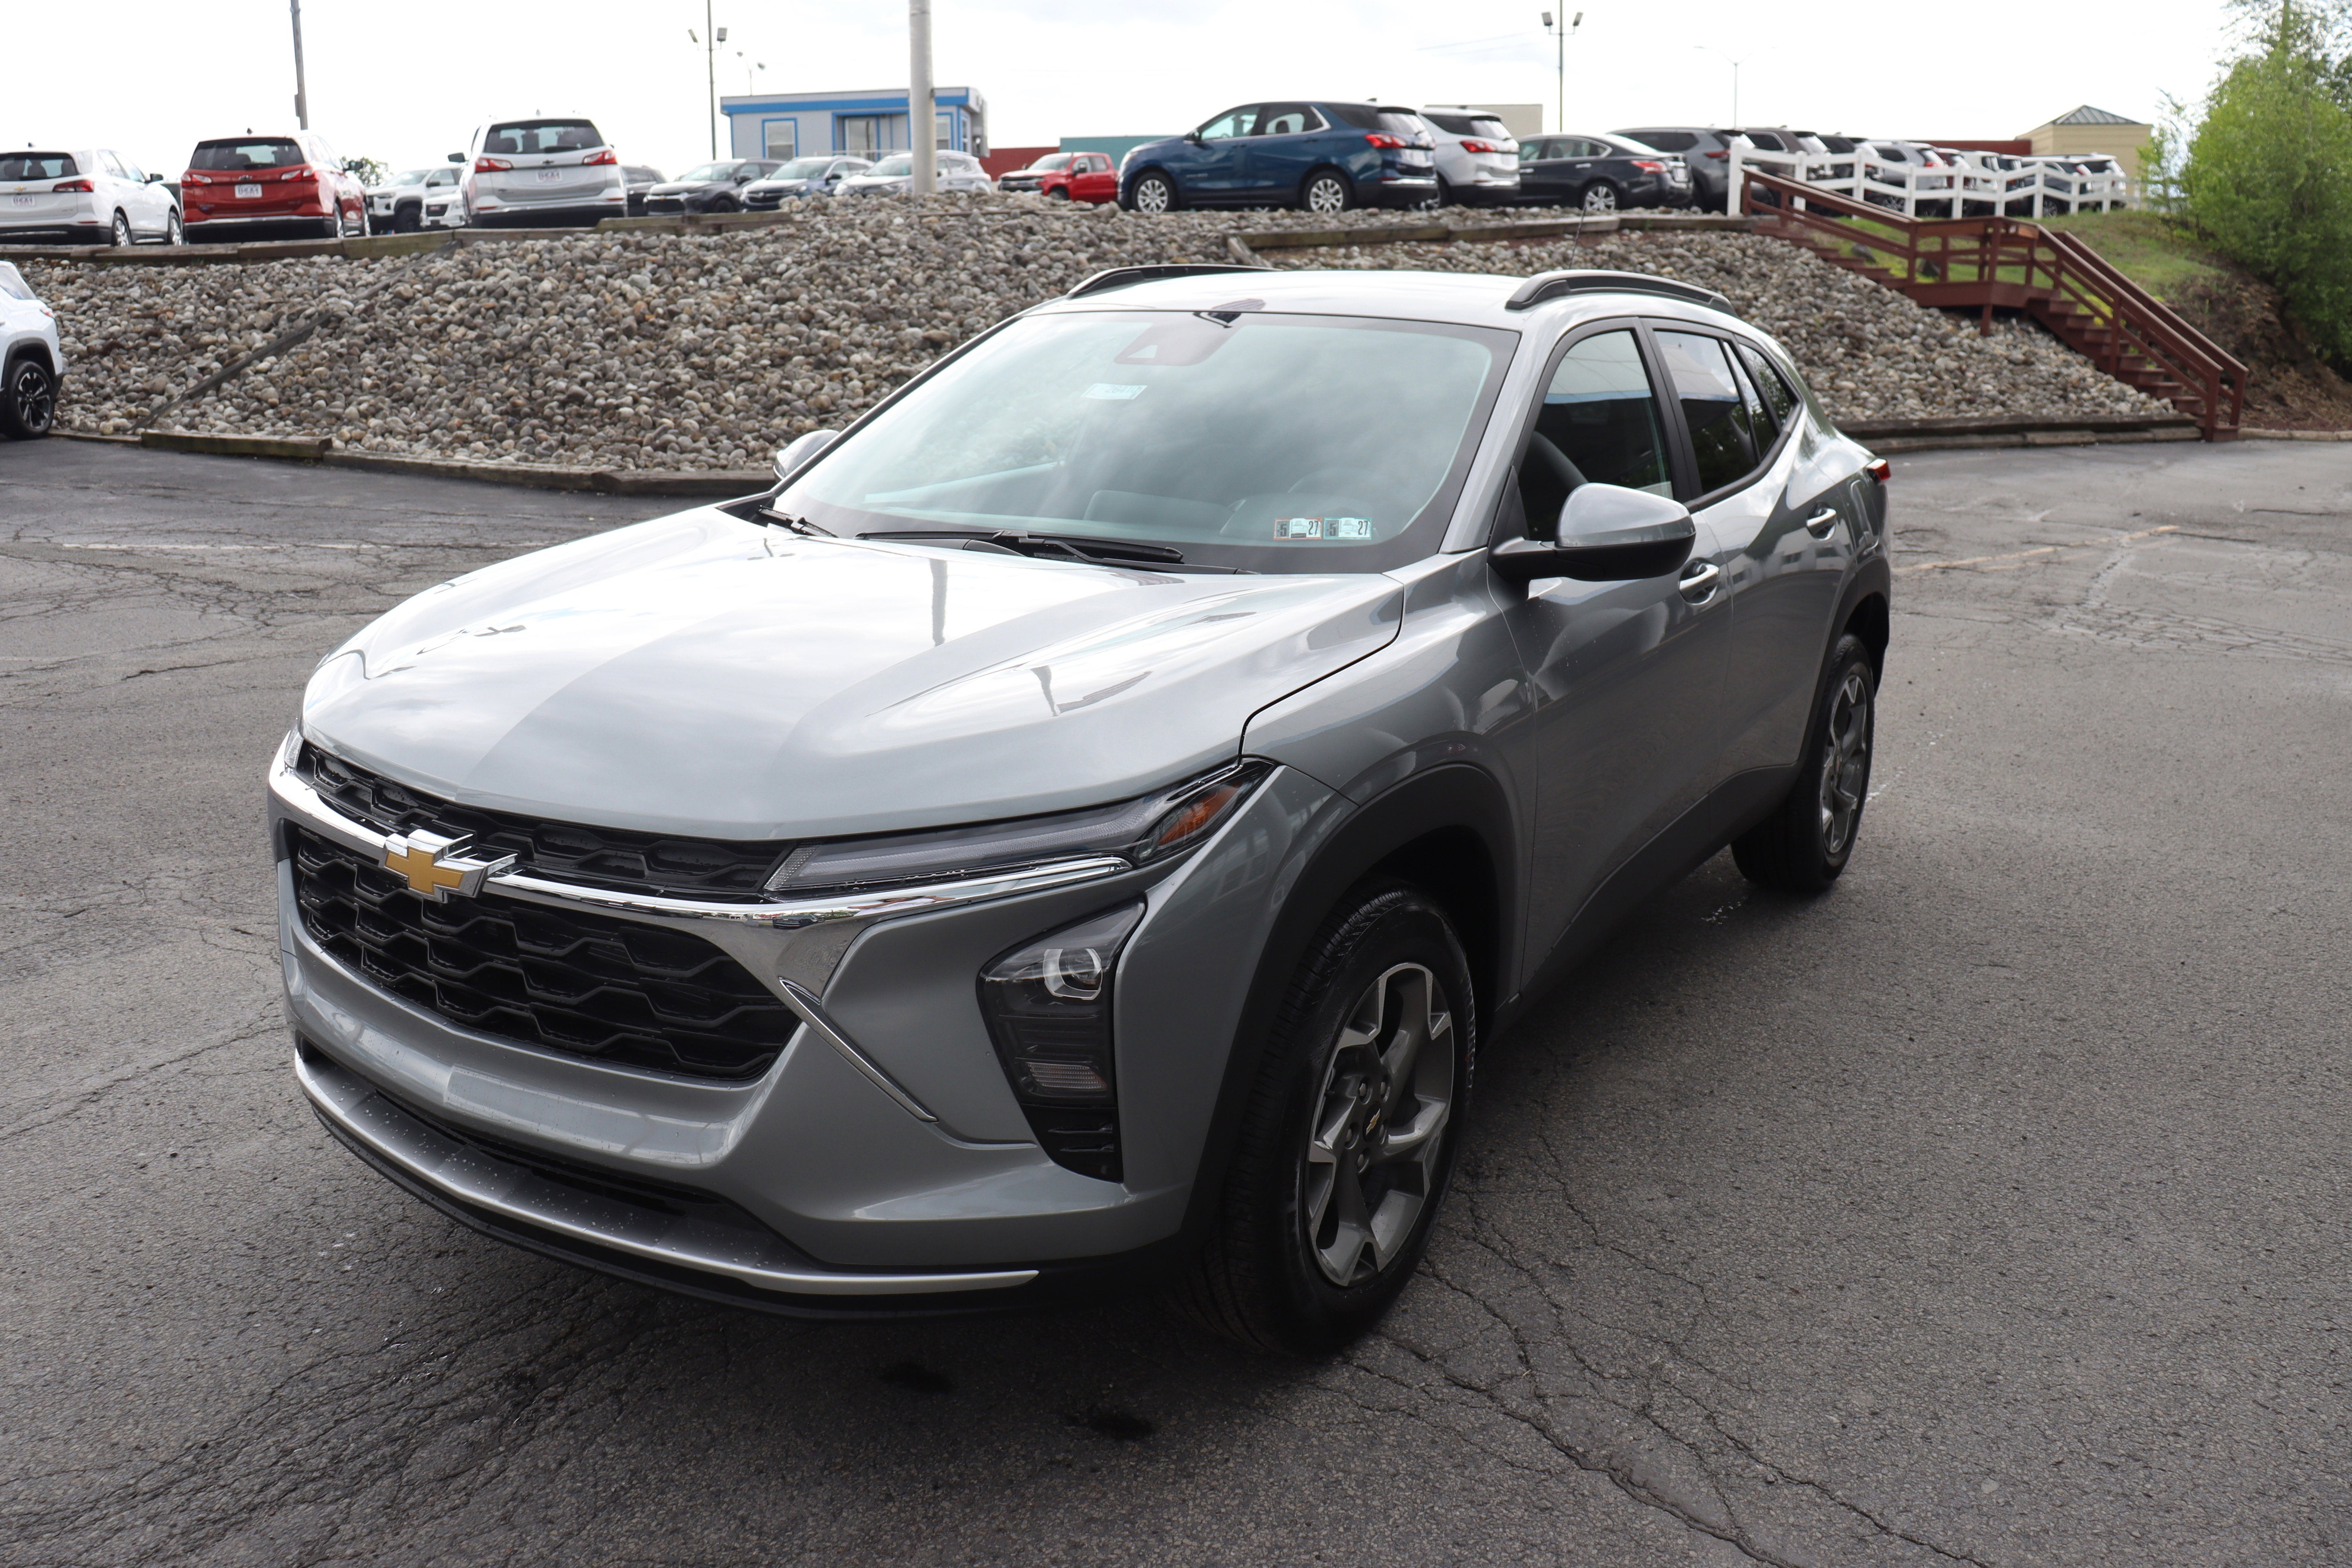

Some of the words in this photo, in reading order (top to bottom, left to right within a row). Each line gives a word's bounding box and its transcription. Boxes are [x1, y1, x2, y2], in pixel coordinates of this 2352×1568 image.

[1280, 523, 1287, 537] 5
[1308, 521, 1319, 536] 27
[1329, 523, 1336, 536] 5
[1358, 520, 1368, 536] 27
